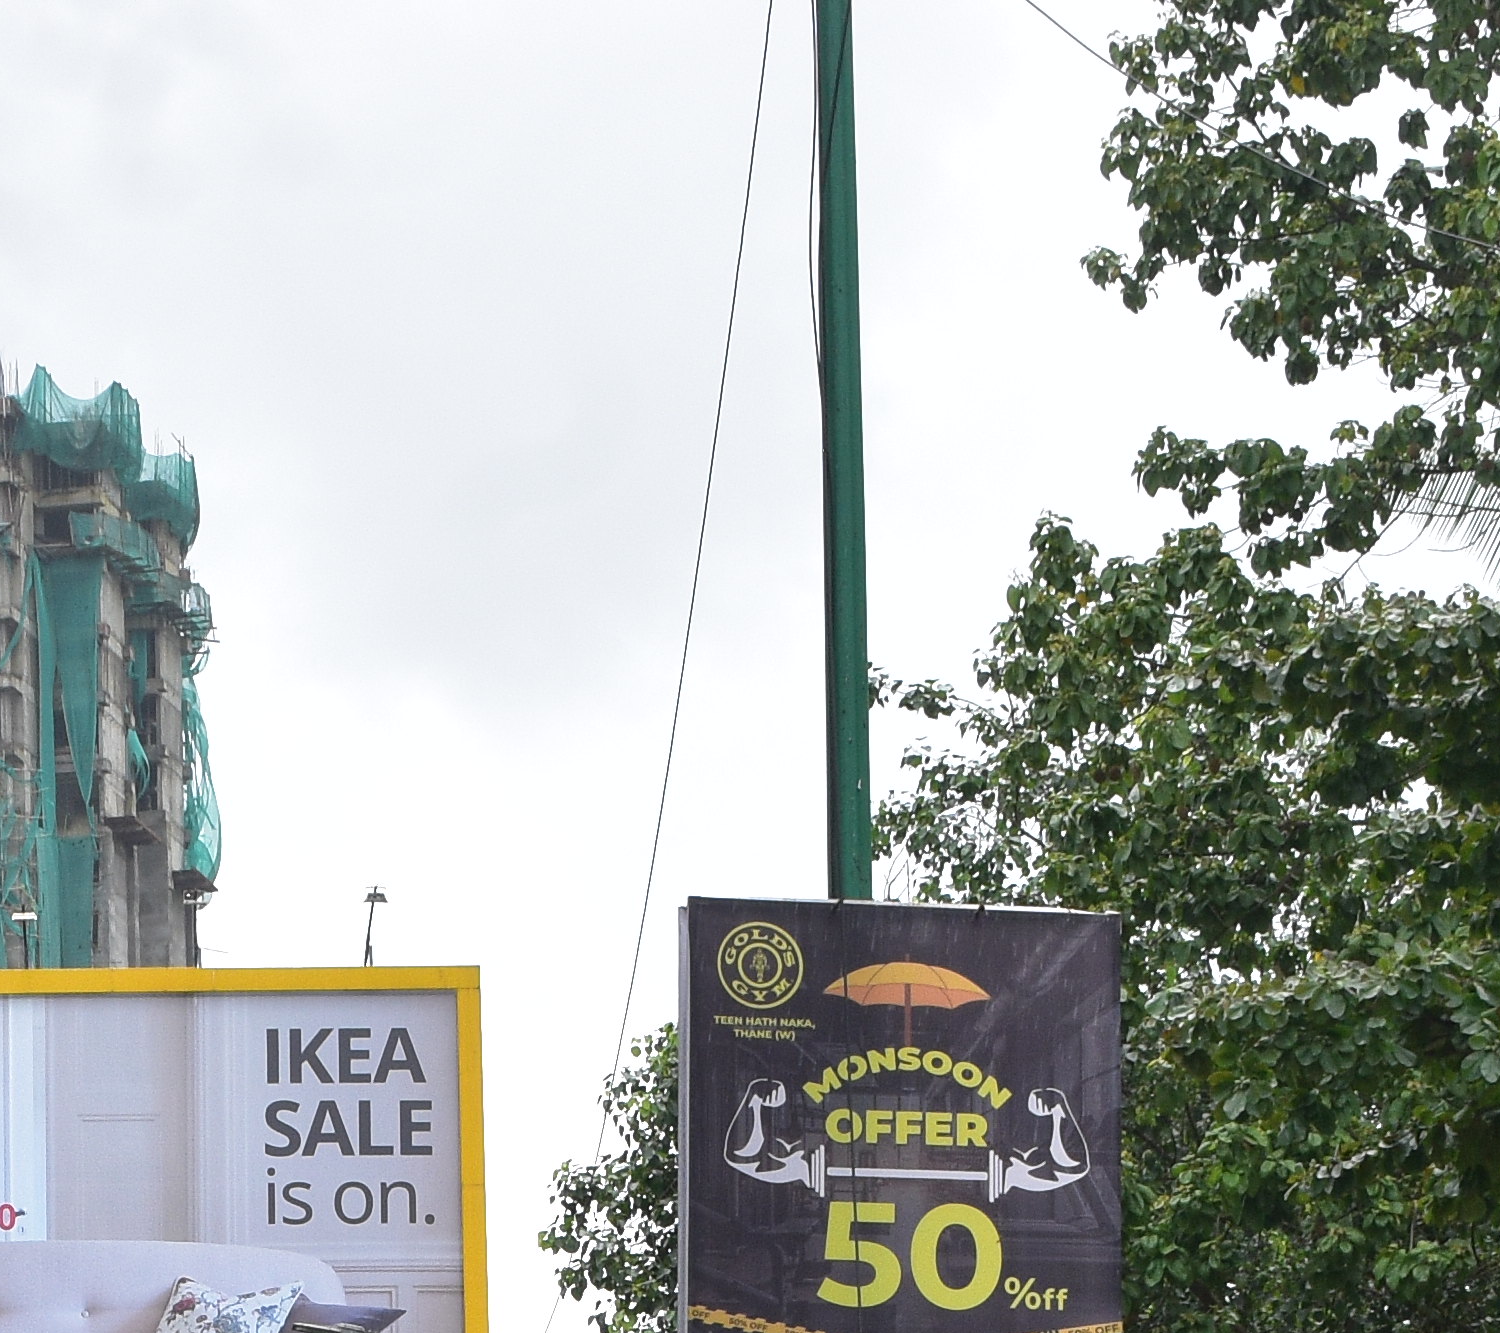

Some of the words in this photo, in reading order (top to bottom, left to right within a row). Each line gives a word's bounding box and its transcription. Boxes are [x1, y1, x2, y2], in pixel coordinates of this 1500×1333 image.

[725, 929, 796, 968] GOLD'S
[731, 978, 792, 1001] GYM
[713, 1015, 743, 1025] TEEN
[745, 1016, 777, 1027] HATH
[780, 1018, 816, 1029] NAKA,
[733, 1029, 772, 1039] THANE
[775, 1030, 796, 1041] (W)
[266, 1027, 425, 1085] IKEA
[802, 1046, 1014, 1110] MONSOON
[263, 1100, 434, 1157] SALE
[824, 1107, 989, 1148] OFFER
[267, 1176, 313, 1225] is
[334, 1184, 436, 1226] on.
[816, 1200, 1003, 1311] 50
[1004, 1276, 1069, 1312] %off
[749, 1321, 768, 1331] OFF
